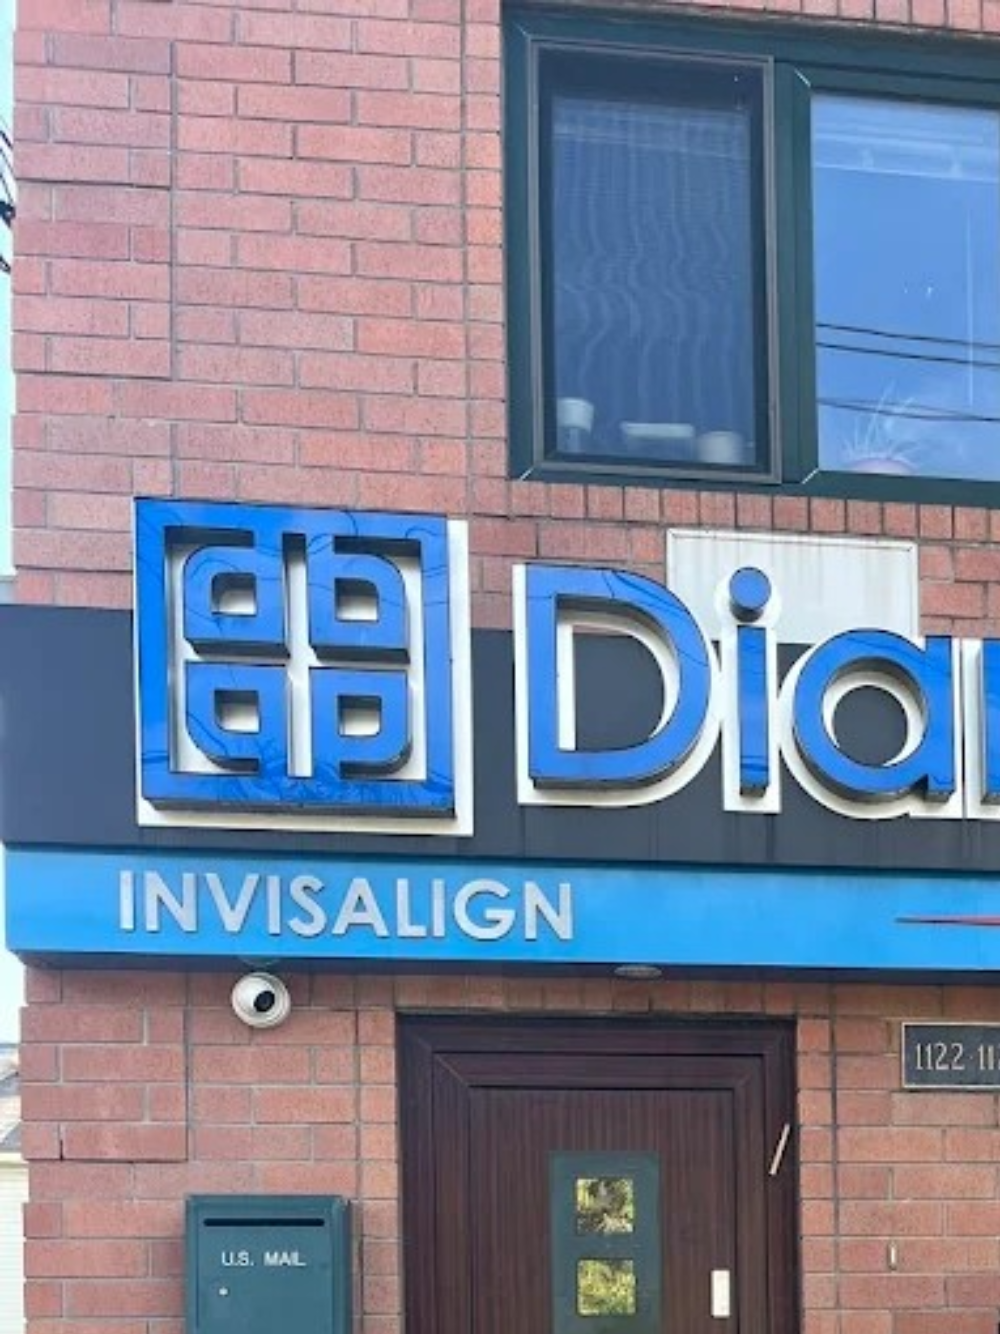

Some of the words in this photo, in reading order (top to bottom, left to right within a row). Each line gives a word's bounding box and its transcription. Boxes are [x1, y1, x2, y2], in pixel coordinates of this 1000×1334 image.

[118, 868, 574, 941] INVISALIGN
[221, 1250, 255, 1266] U.S.
[263, 1250, 307, 1266] MAIL
